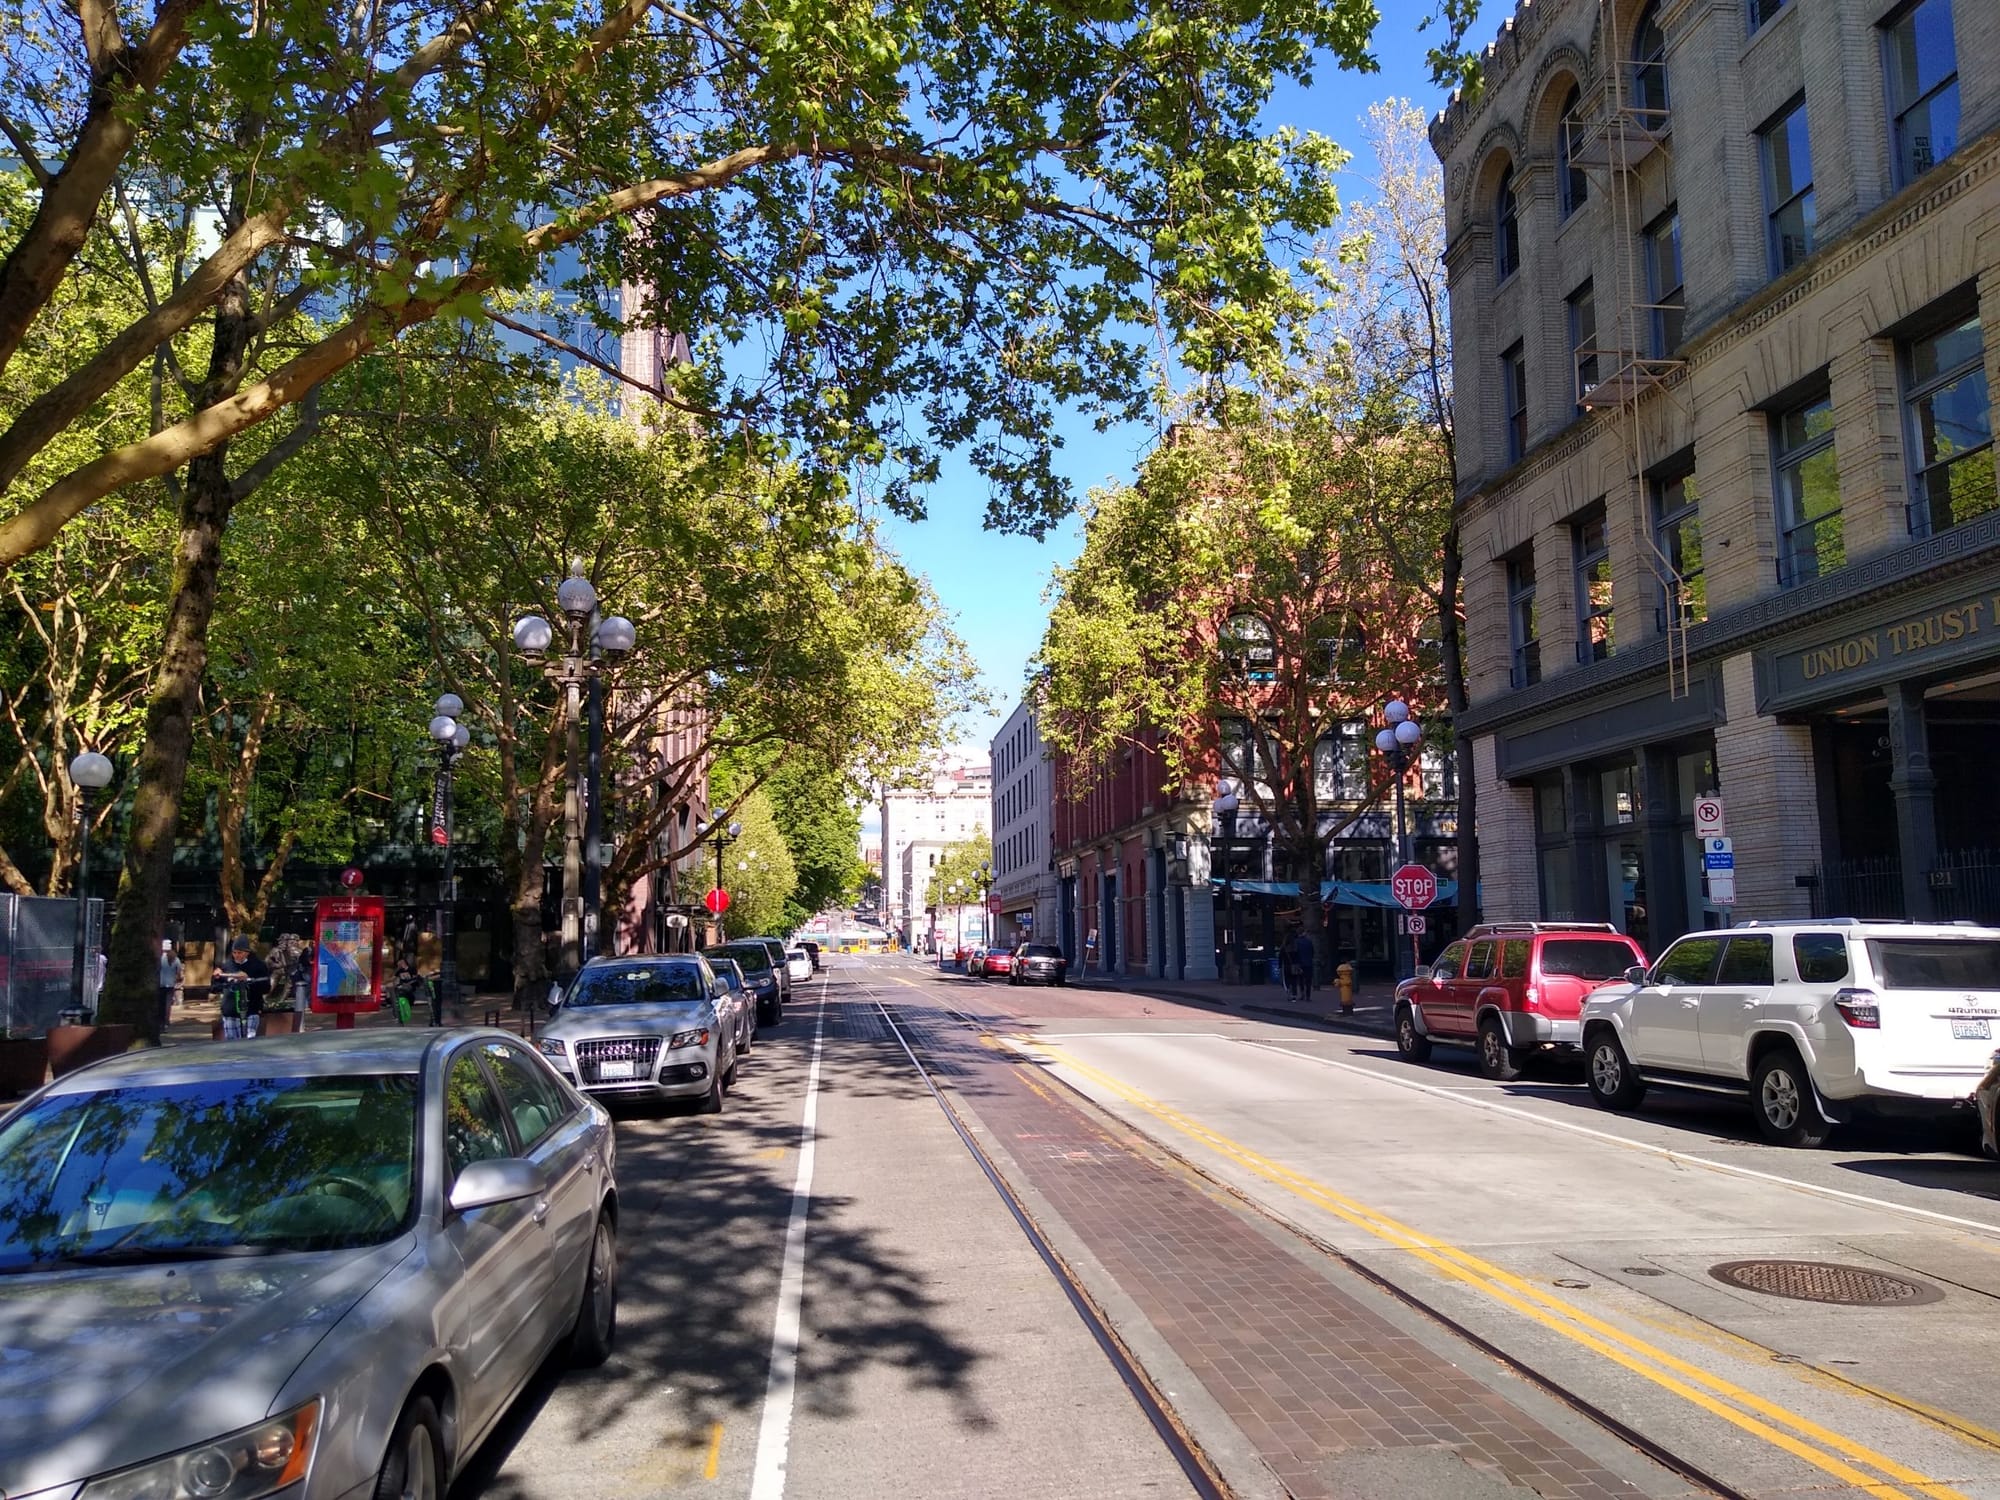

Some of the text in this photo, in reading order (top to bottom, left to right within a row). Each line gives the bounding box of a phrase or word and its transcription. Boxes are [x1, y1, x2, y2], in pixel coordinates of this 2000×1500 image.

[1802, 634, 1879, 679] UNION
[1887, 603, 1984, 656] TRUST
[1930, 871, 1952, 886] 121
[1395, 879, 1433, 895] STOP
